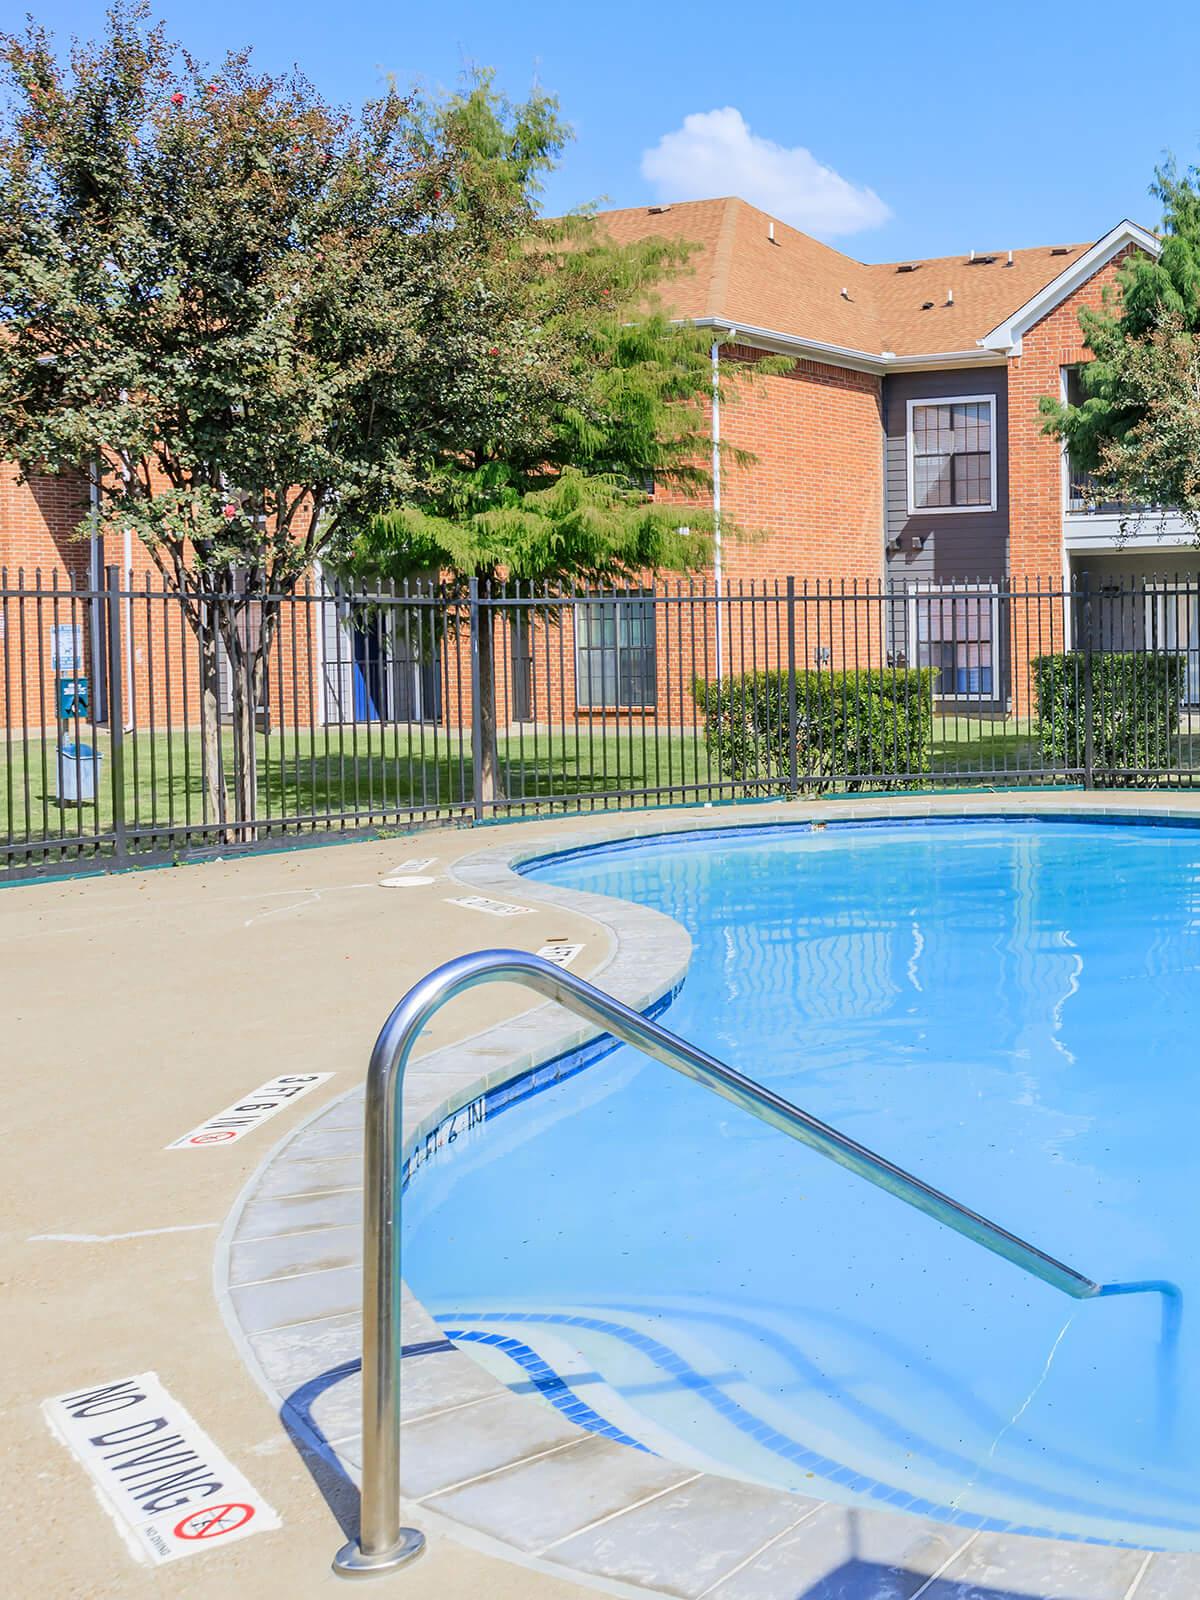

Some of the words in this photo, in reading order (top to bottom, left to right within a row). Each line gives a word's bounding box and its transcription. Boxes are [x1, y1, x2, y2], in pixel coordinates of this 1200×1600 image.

[253, 1086, 305, 1098] FT
[234, 1102, 280, 1112] 6
[203, 1115, 262, 1129] IN
[426, 1127, 439, 1160] FT
[448, 1115, 458, 1143] 6
[468, 1098, 482, 1130] IN
[61, 1381, 147, 1418] NO
[88, 1416, 223, 1515] DIVING
